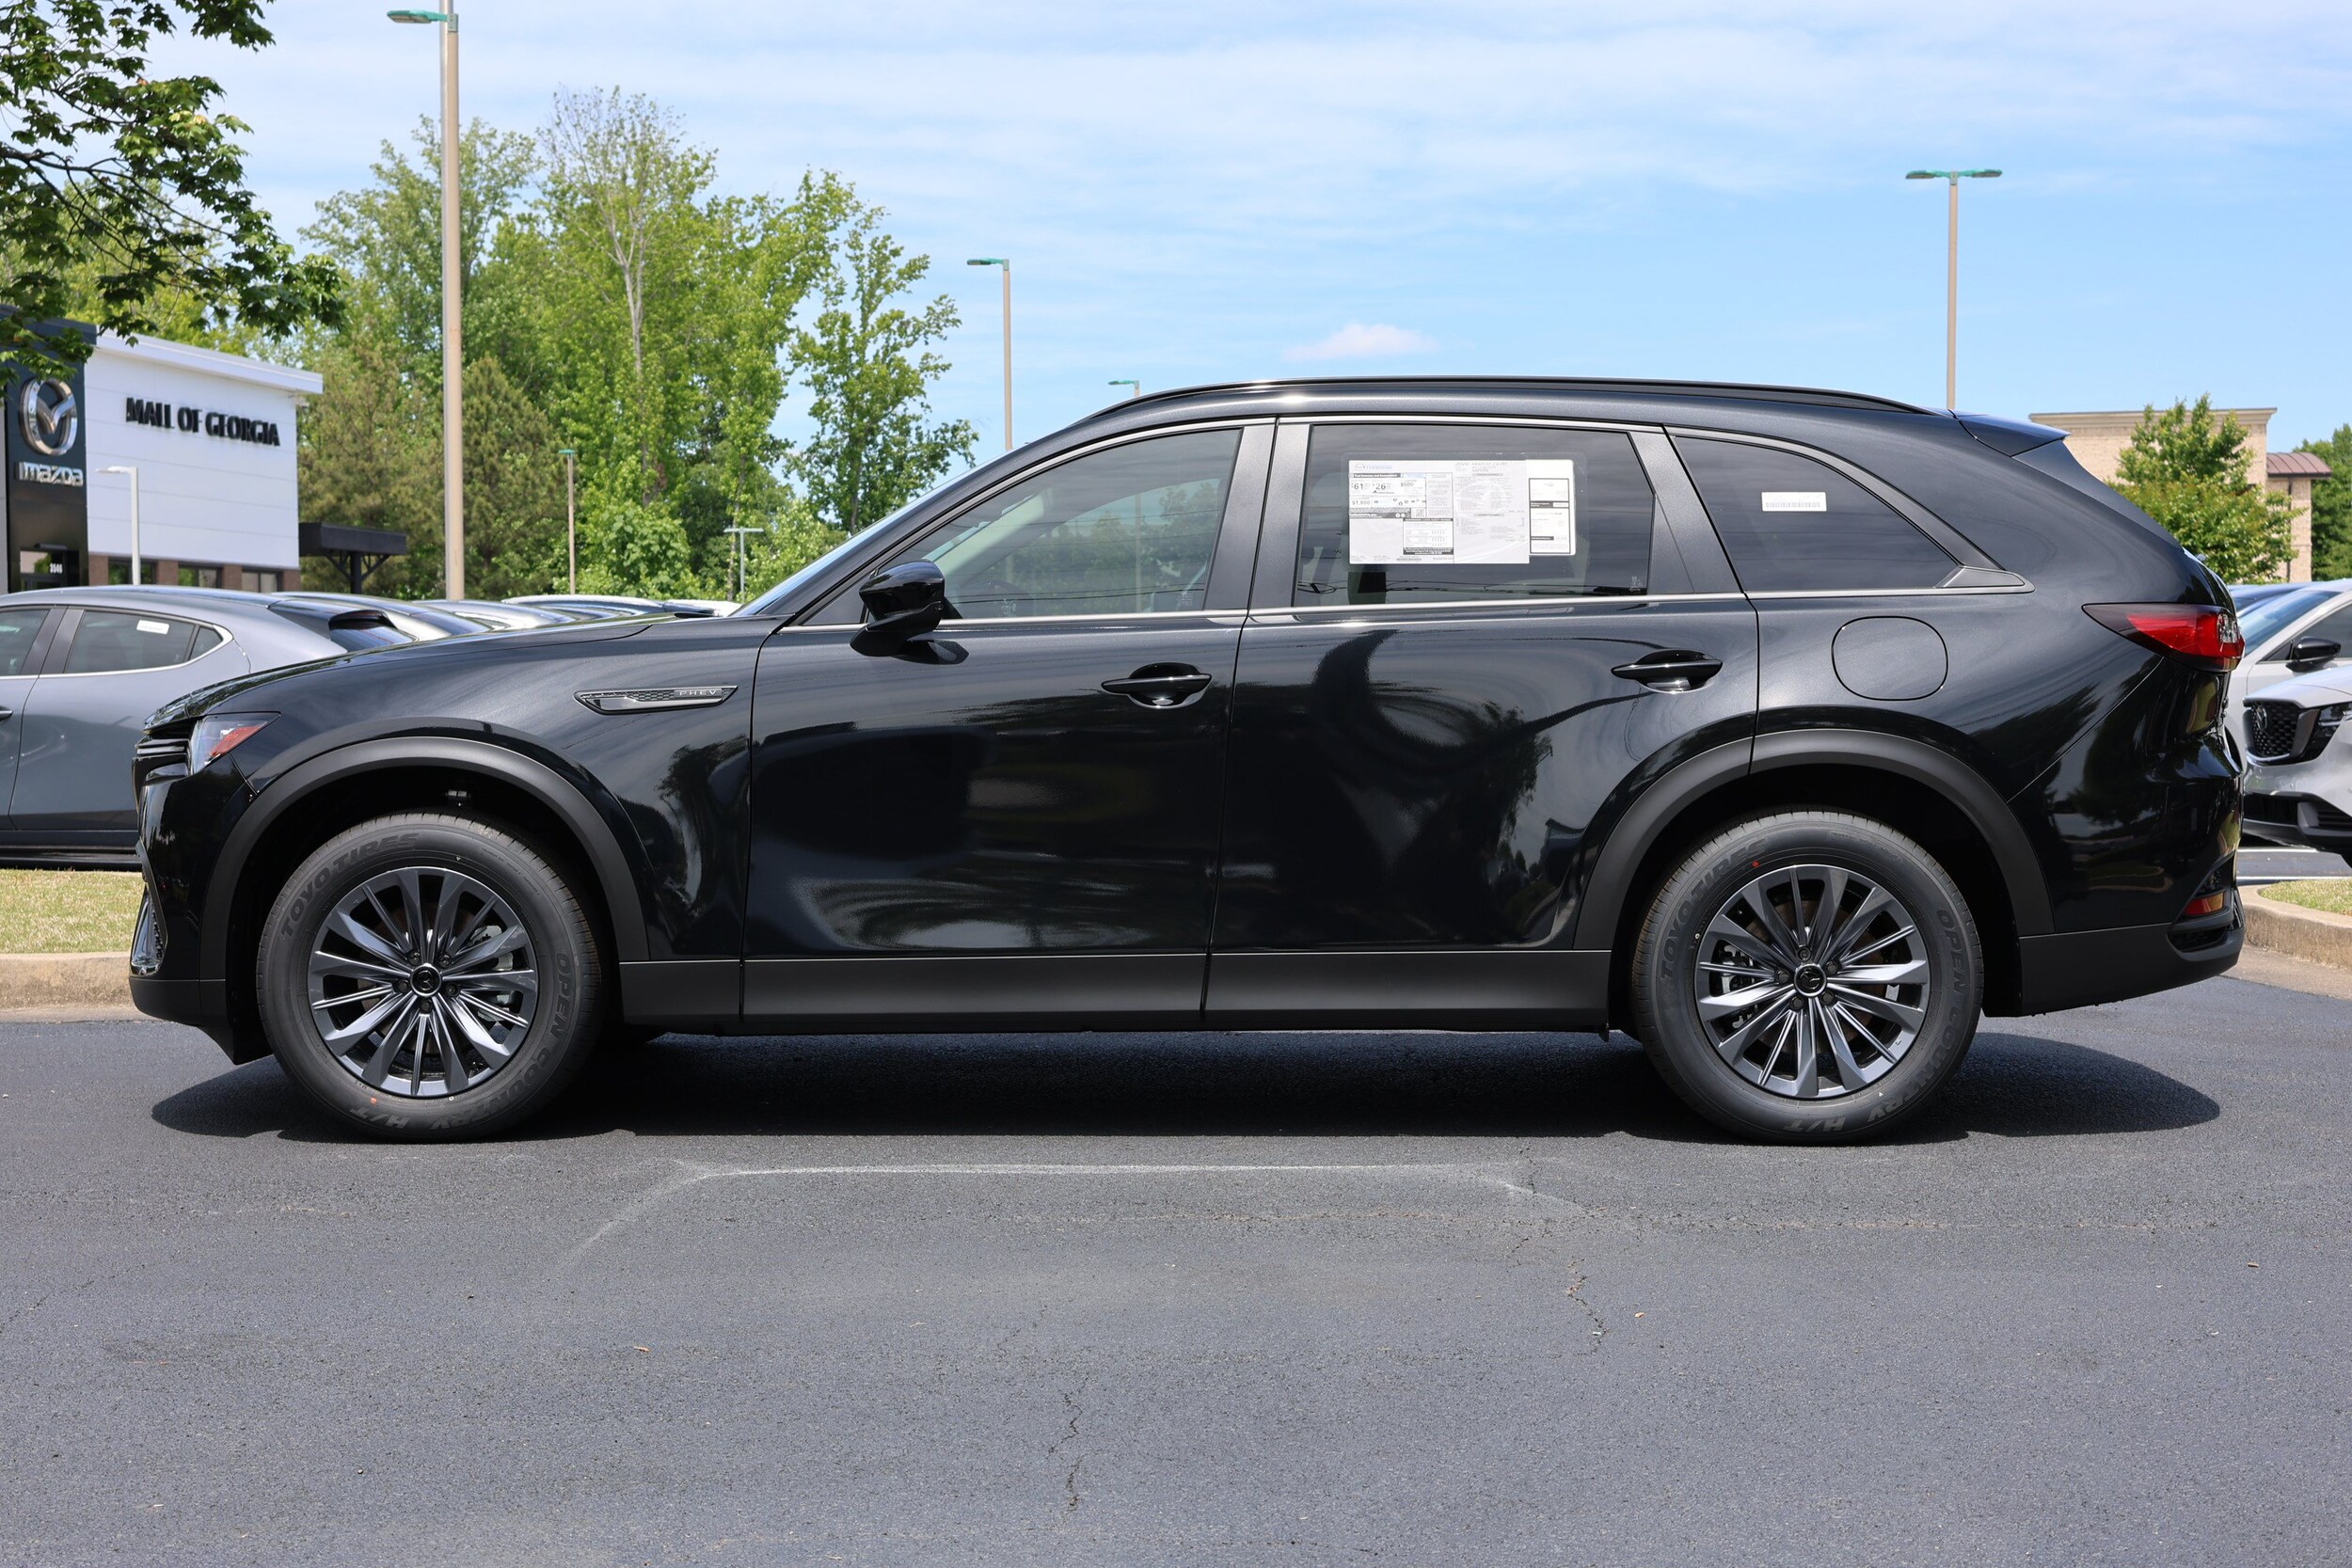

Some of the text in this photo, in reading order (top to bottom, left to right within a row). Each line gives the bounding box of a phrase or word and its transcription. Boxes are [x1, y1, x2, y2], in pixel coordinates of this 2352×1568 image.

[125, 397, 280, 447] MALL OF GEORGIA
[281, 868, 331, 939] TOYO
[330, 832, 420, 873] TIRES
[1661, 837, 1768, 981] TOYO TIRES
[1936, 907, 1968, 993] OPEN
[349, 952, 571, 1131] OPEN COUNTRY H/T
[1867, 1008, 1968, 1123] COUNTRY
[1781, 1117, 1847, 1132] H/T
